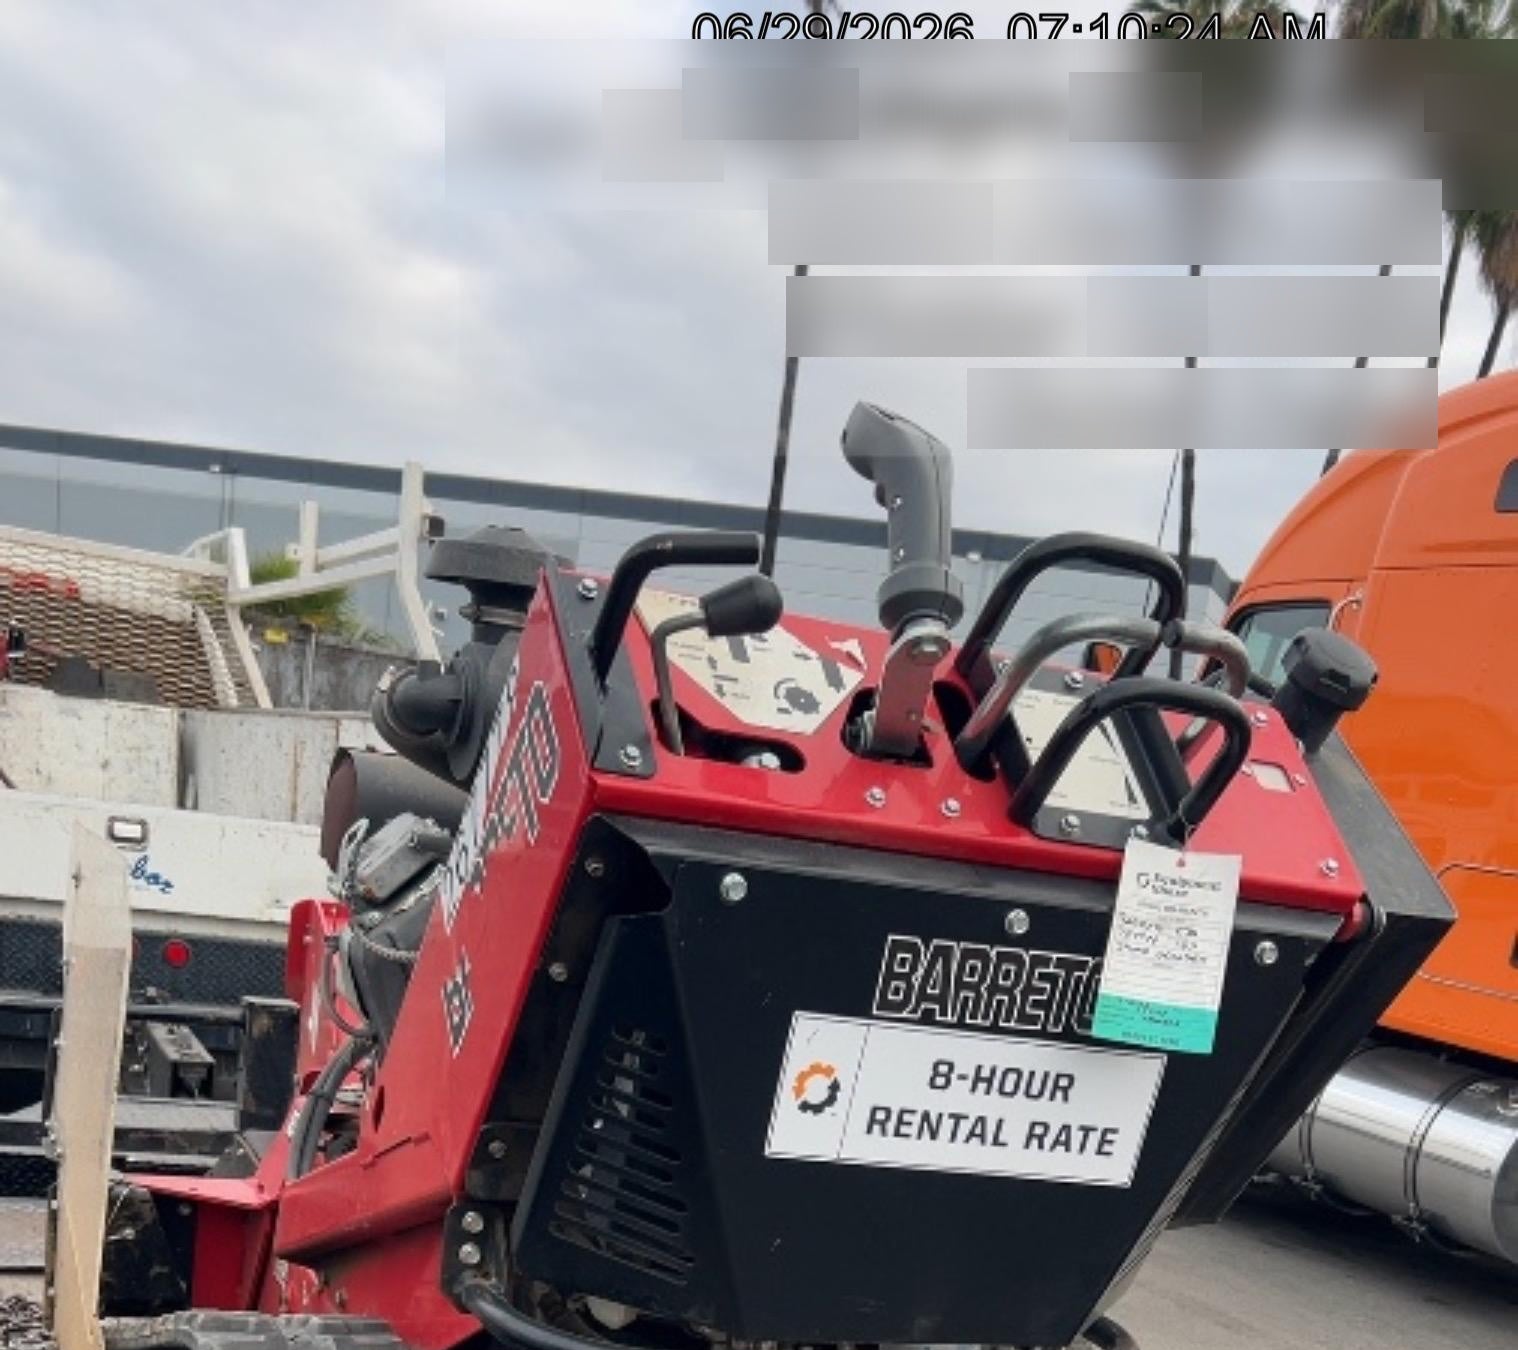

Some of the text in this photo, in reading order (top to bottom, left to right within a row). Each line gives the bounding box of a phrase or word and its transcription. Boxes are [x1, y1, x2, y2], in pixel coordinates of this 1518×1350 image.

[929, 1059, 1075, 1103] 8-HOUR
[866, 1106, 1120, 1156] RENTAL RATE
